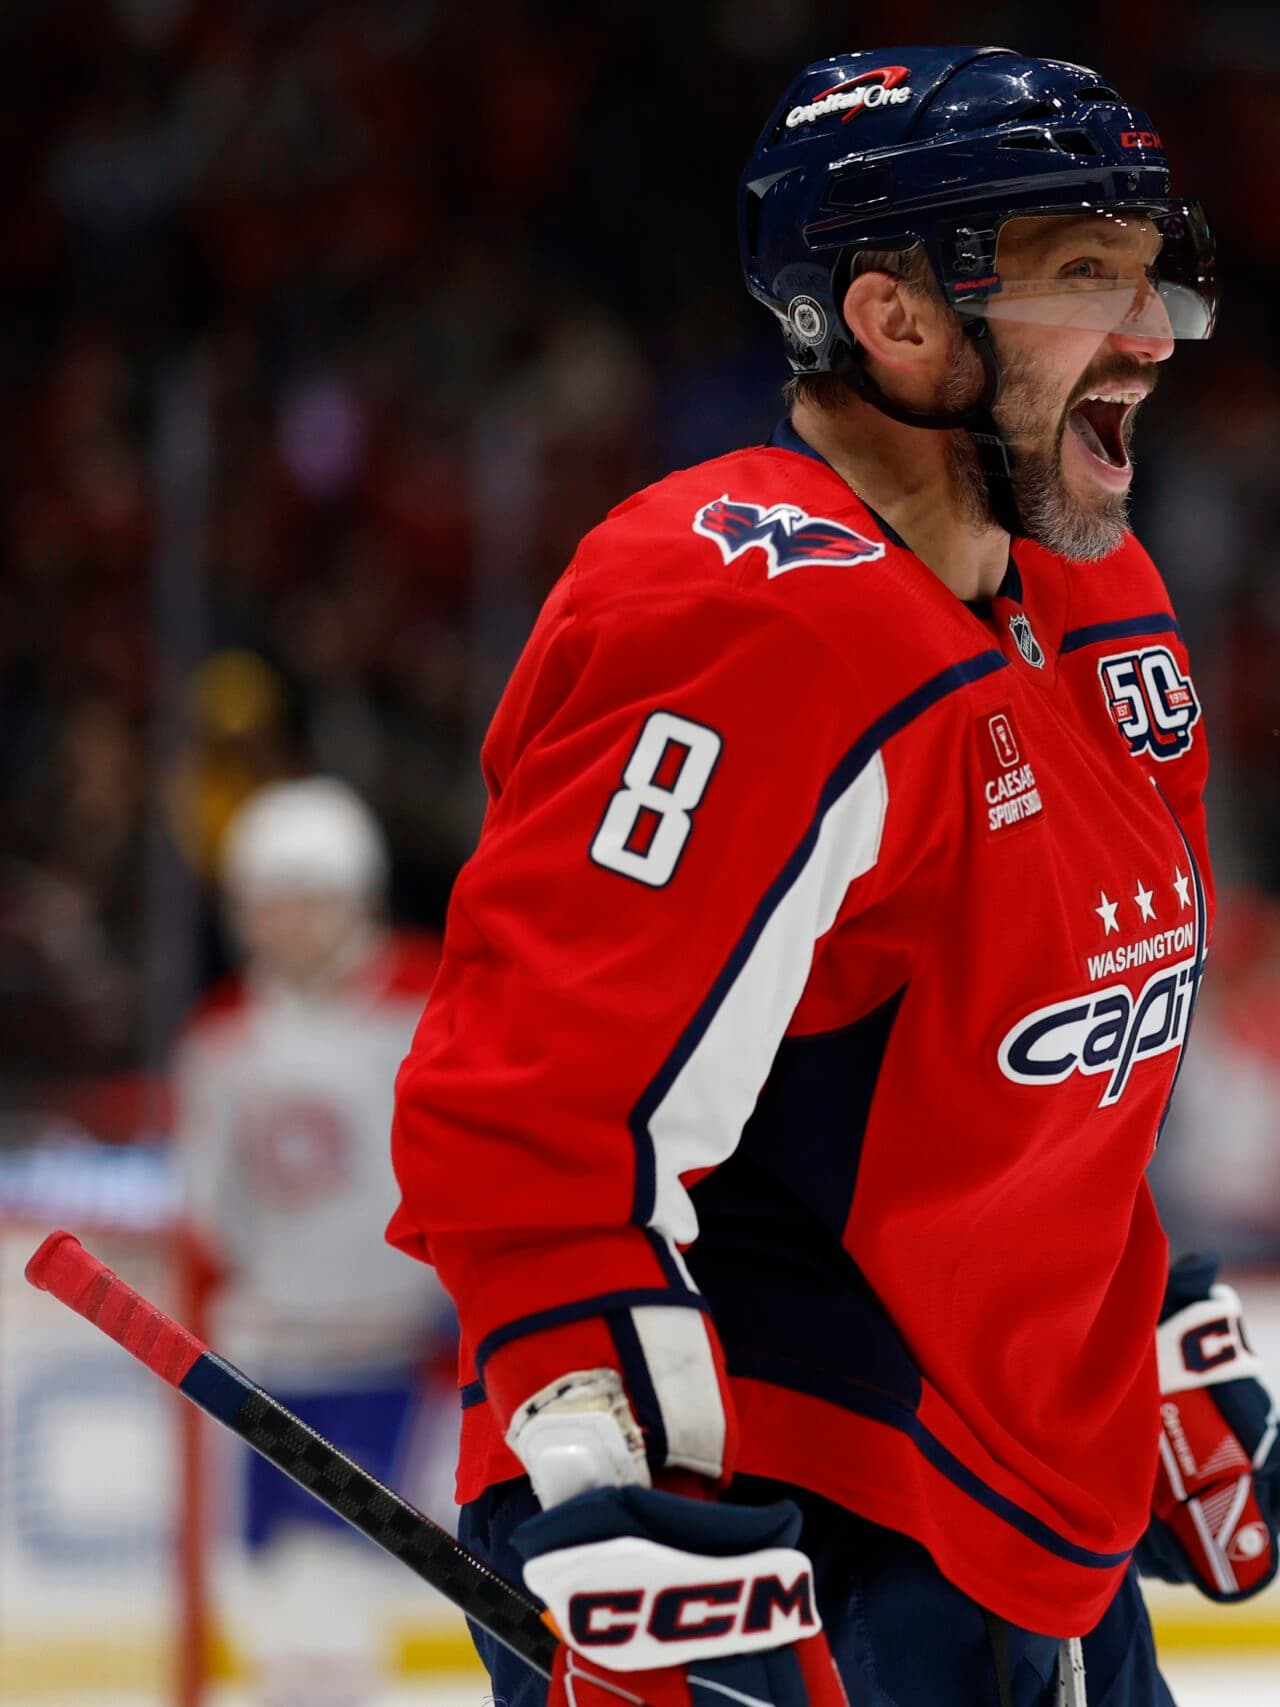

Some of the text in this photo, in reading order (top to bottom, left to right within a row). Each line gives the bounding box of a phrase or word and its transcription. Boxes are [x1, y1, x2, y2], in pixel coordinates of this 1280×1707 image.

[1104, 650, 1192, 742] 50
[589, 708, 724, 889] 8
[1087, 921, 1194, 982] WASHINGTON
[568, 1571, 816, 1647] CCM
